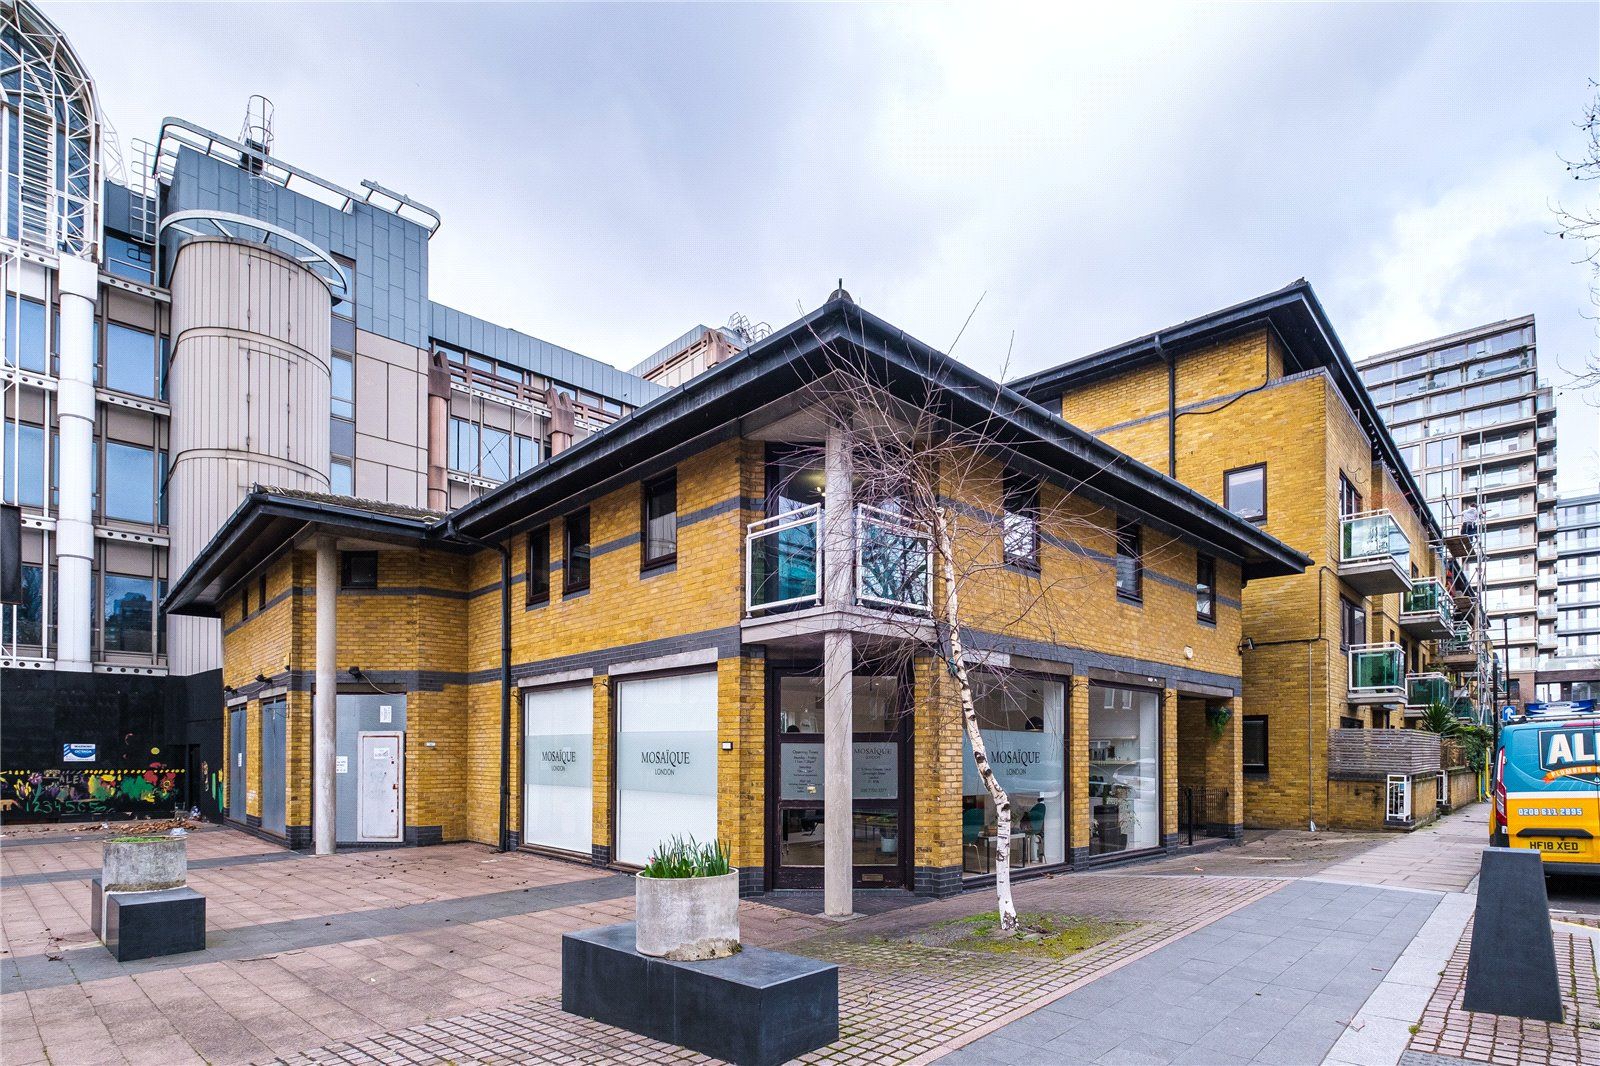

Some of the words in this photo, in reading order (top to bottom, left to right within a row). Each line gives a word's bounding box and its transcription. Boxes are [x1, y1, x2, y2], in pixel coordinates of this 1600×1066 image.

[541, 749, 576, 765] MOSAÏQUE
[641, 749, 690, 767] MOSAÏQUE
[990, 748, 1041, 767] MOSAÏQUE
[1006, 768, 1027, 776] LONDON
[1551, 766, 1592, 777] PLUMBING
[1518, 807, 1540, 816] 0208
[1530, 841, 1554, 850] HF18
[1557, 842, 1579, 851] XED
